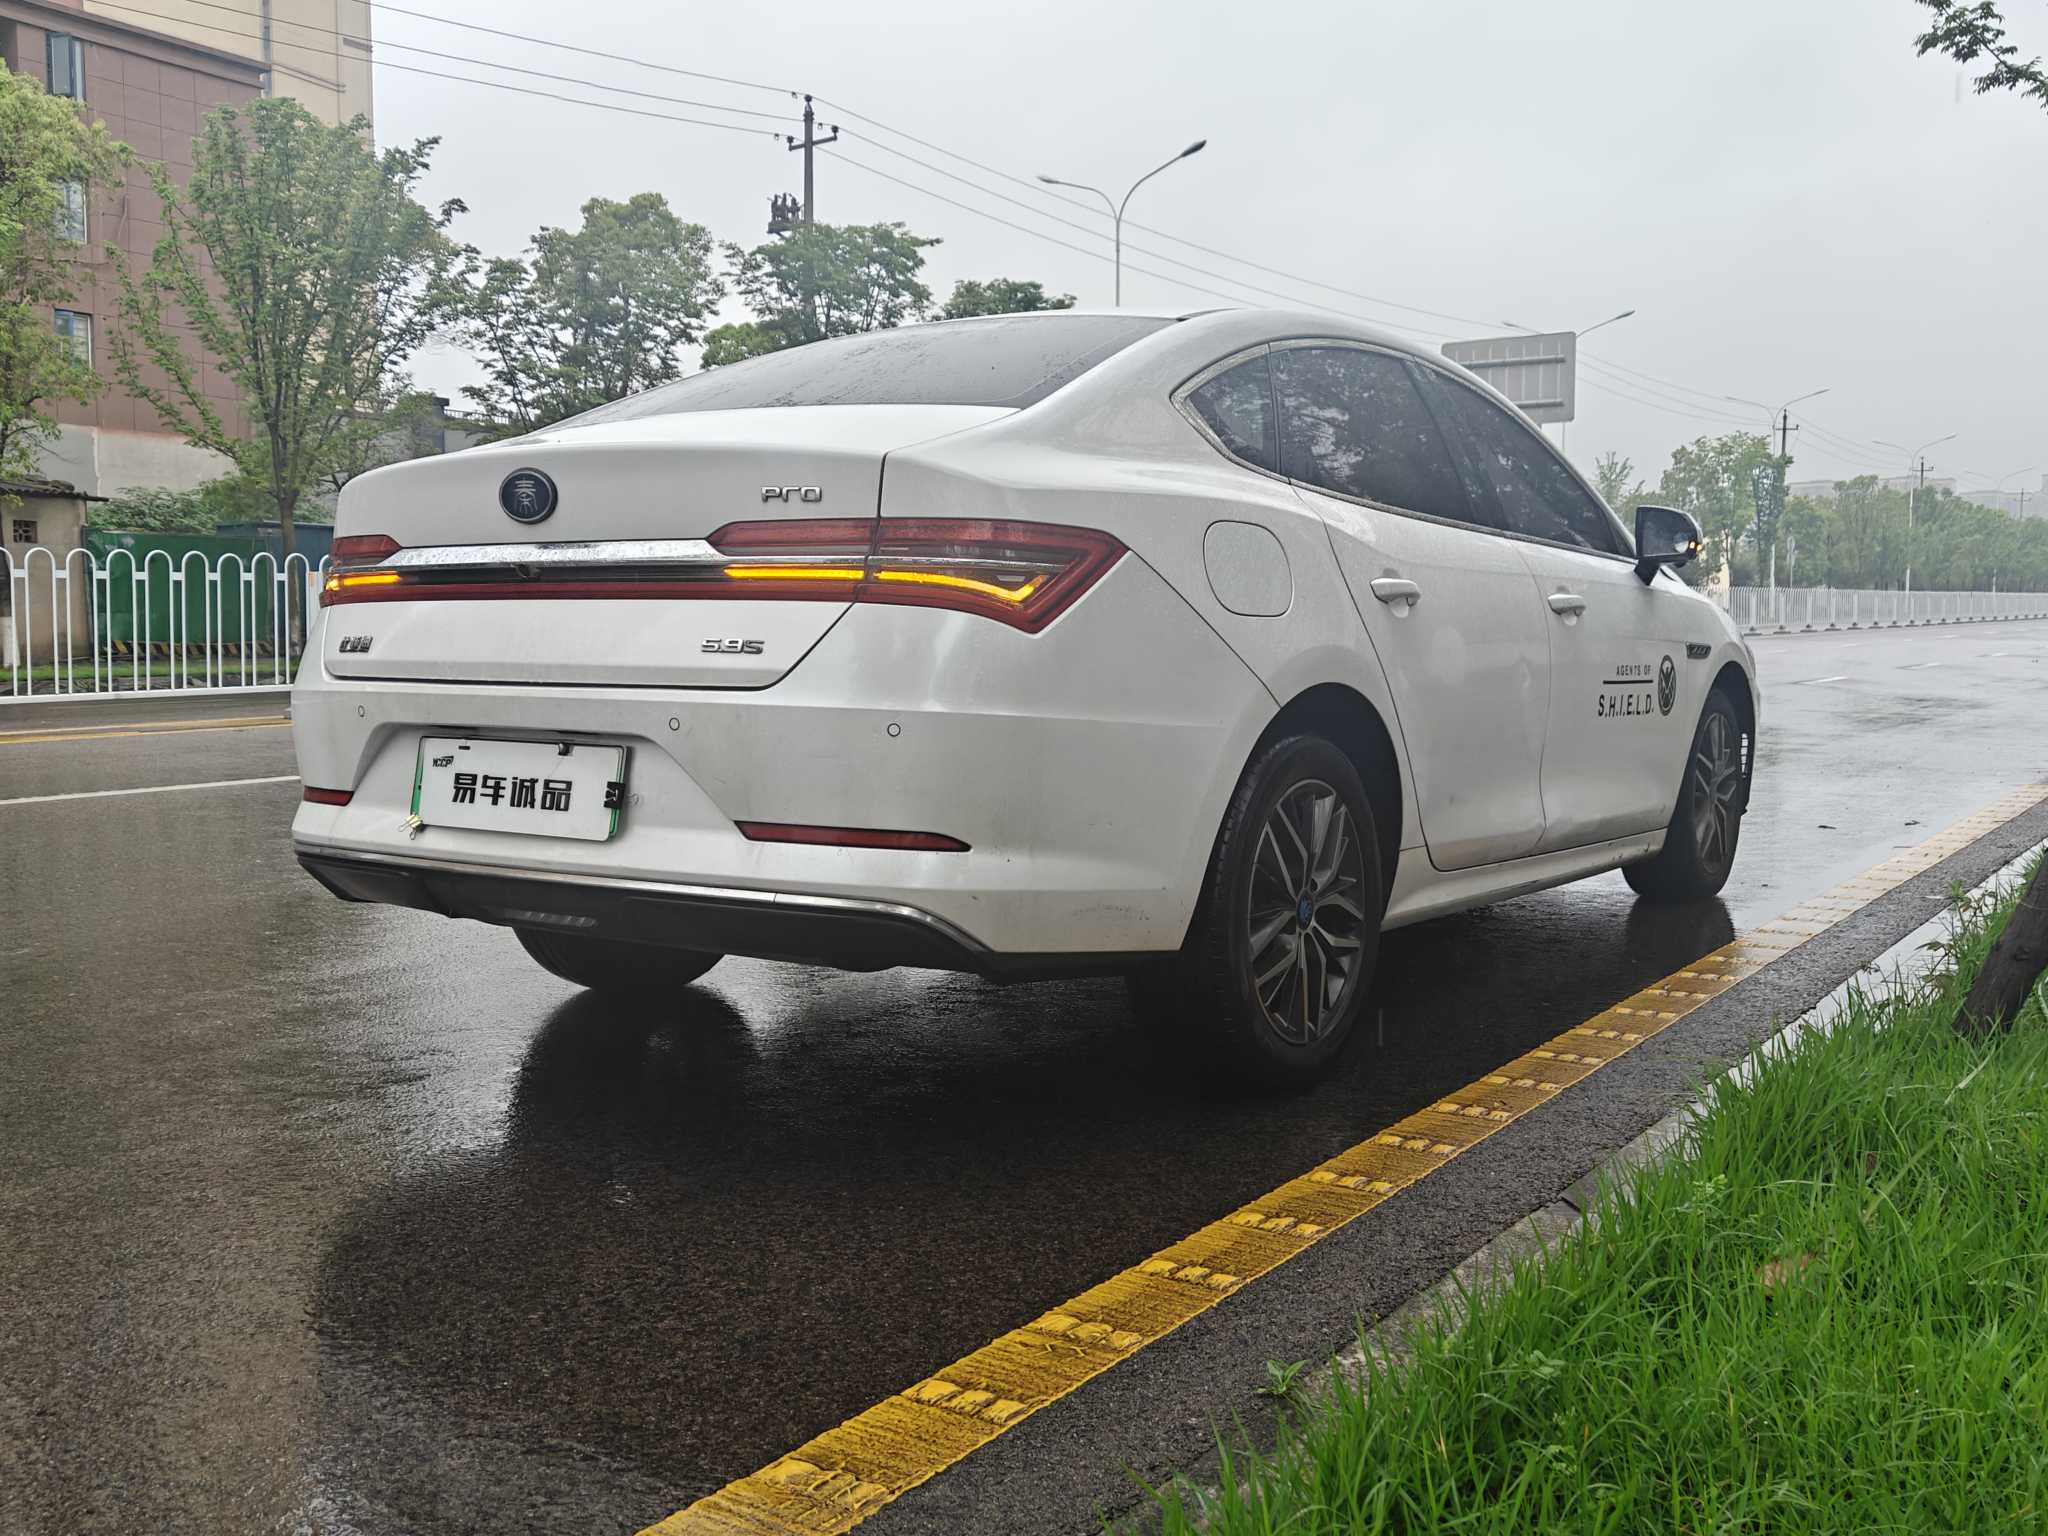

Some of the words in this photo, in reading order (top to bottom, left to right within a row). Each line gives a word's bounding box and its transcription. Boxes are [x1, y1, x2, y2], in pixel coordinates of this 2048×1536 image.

[1616, 664, 1641, 676] AGENTS
[1643, 664, 1652, 676] OF
[452, 773, 572, 811] 易车诚品
